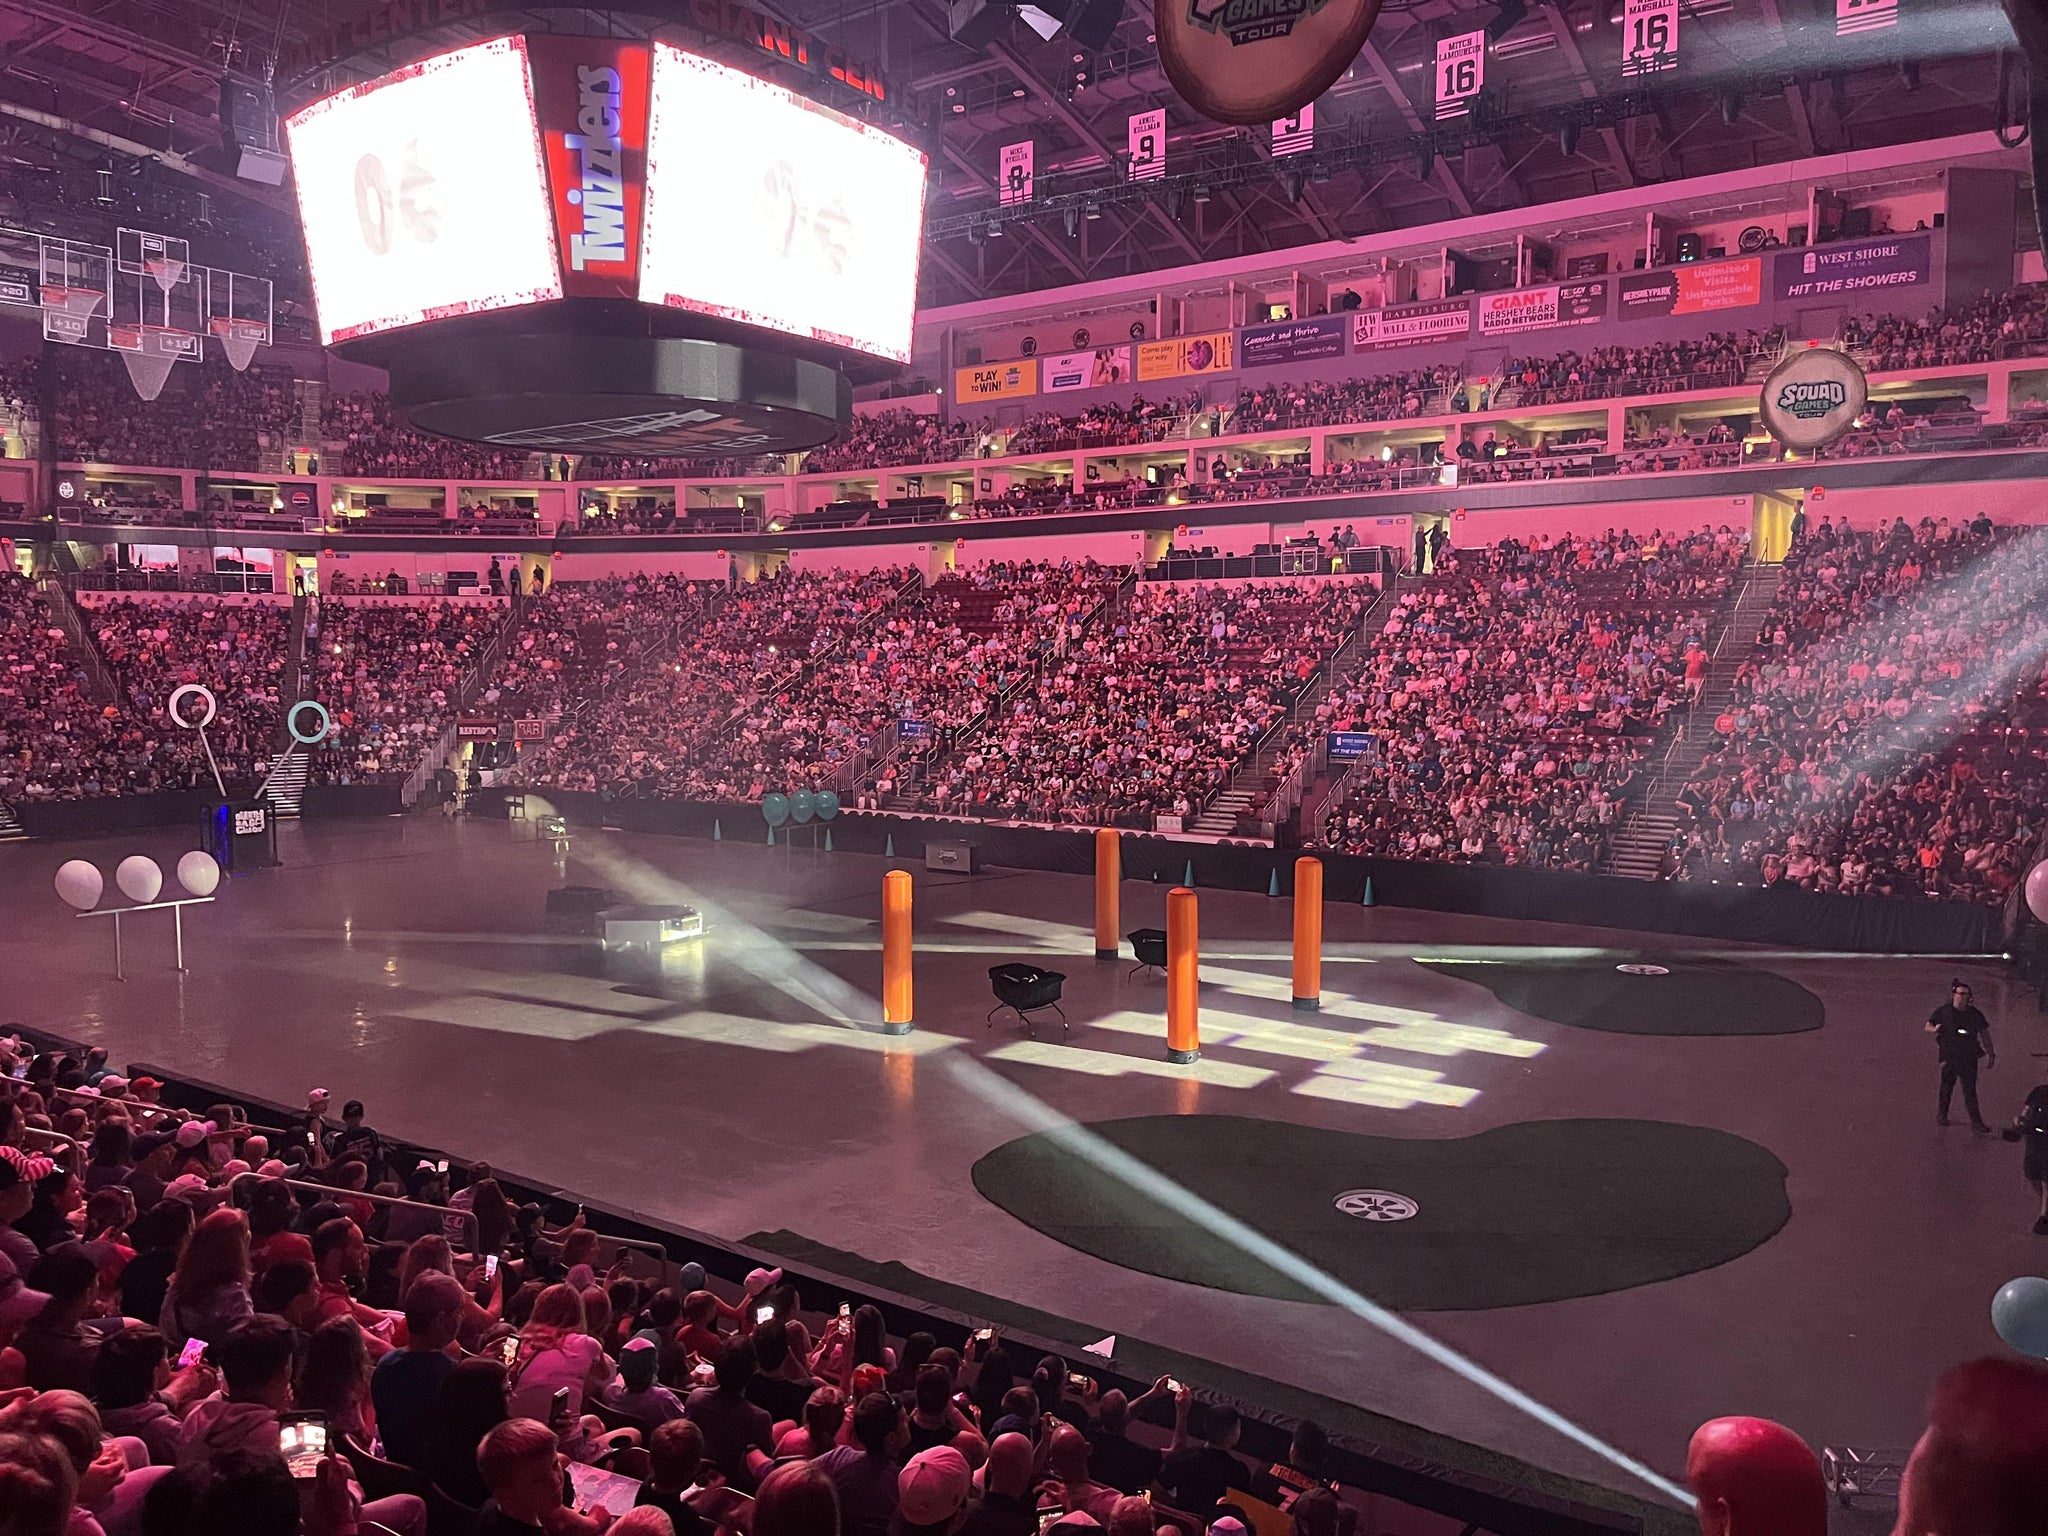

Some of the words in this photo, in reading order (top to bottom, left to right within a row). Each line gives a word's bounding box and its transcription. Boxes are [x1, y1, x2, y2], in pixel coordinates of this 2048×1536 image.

[1629, 0, 1673, 15] MARSHALL
[1236, 23, 1287, 41] TOUR
[1633, 13, 1669, 52] 16
[1448, 38, 1473, 51] MITCH
[1444, 60, 1475, 97] 16
[1140, 135, 1154, 161] 9
[565, 65, 625, 271] Twizzlers
[1011, 165, 1023, 192] 8
[1819, 251, 1854, 264] WEST
[1855, 245, 1899, 261] SHORE
[1693, 263, 1749, 279] Unlimited
[2, 286, 23, 296] +20
[1788, 283, 1812, 296] HIT
[1815, 279, 1843, 293] THE
[1845, 270, 1917, 289] SHOWERS
[1491, 291, 1547, 310] GIANT
[1623, 286, 1672, 302] HERSHEYPARK
[1685, 284, 1754, 301] Unbeatable
[1385, 302, 1466, 320] HARRISBURG
[1483, 307, 1525, 320] HERSHEY
[1526, 303, 1556, 315] BEARS
[54, 318, 82, 330] +10
[1359, 314, 1377, 327] HW
[1383, 322, 1408, 335] WALL
[1408, 322, 1417, 332] &
[1419, 315, 1467, 330] FLOORING
[1483, 317, 1514, 328] RADIO
[1515, 312, 1556, 324] NETWORK
[1244, 332, 1276, 346] Connect
[1278, 324, 1292, 340] and
[1294, 320, 1319, 337] thrive
[1160, 344, 1174, 353] play
[1375, 342, 1385, 350] You
[974, 370, 997, 383] PLAY
[979, 380, 1002, 393] WIN!
[1779, 382, 1844, 407] SQUAD
[1794, 400, 1829, 410] GAMES
[518, 722, 540, 736] BAR
